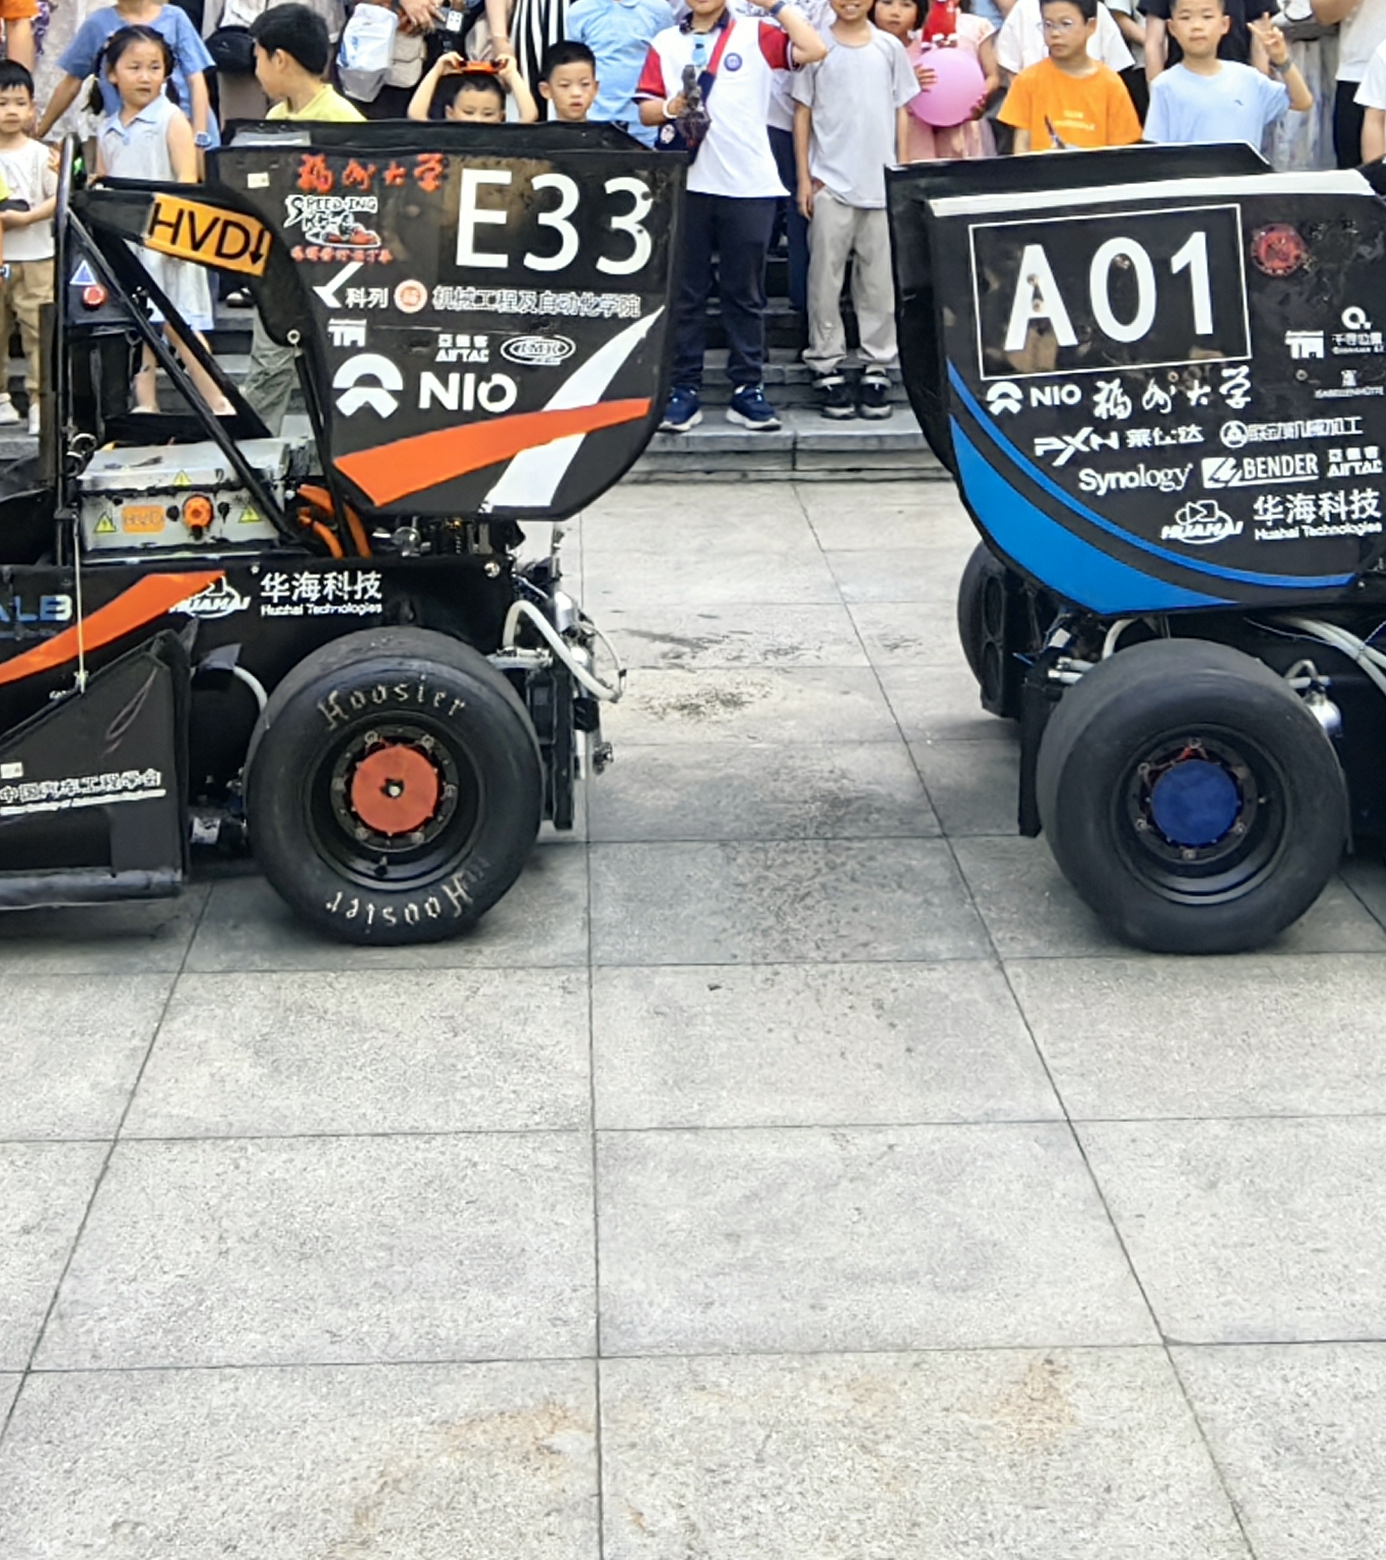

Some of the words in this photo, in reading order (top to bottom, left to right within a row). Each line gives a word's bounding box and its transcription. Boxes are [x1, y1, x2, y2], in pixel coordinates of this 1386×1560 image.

[148, 203, 249, 262] HVD
[456, 168, 653, 275] E33
[345, 287, 389, 309] 科列
[431, 284, 642, 318] 机械工程及自动化学院
[1004, 231, 1213, 351] A01
[419, 371, 517, 413] NIO
[1031, 384, 1081, 408] NIO
[1093, 365, 1251, 420] 福州大学
[1034, 426, 1120, 466] PXN
[1079, 463, 1193, 495] Synology
[1243, 454, 1318, 480] BENDER
[1253, 488, 1383, 525] 华海科技
[261, 571, 383, 602] 华海科技
[317, 674, 466, 731] Hoosier
